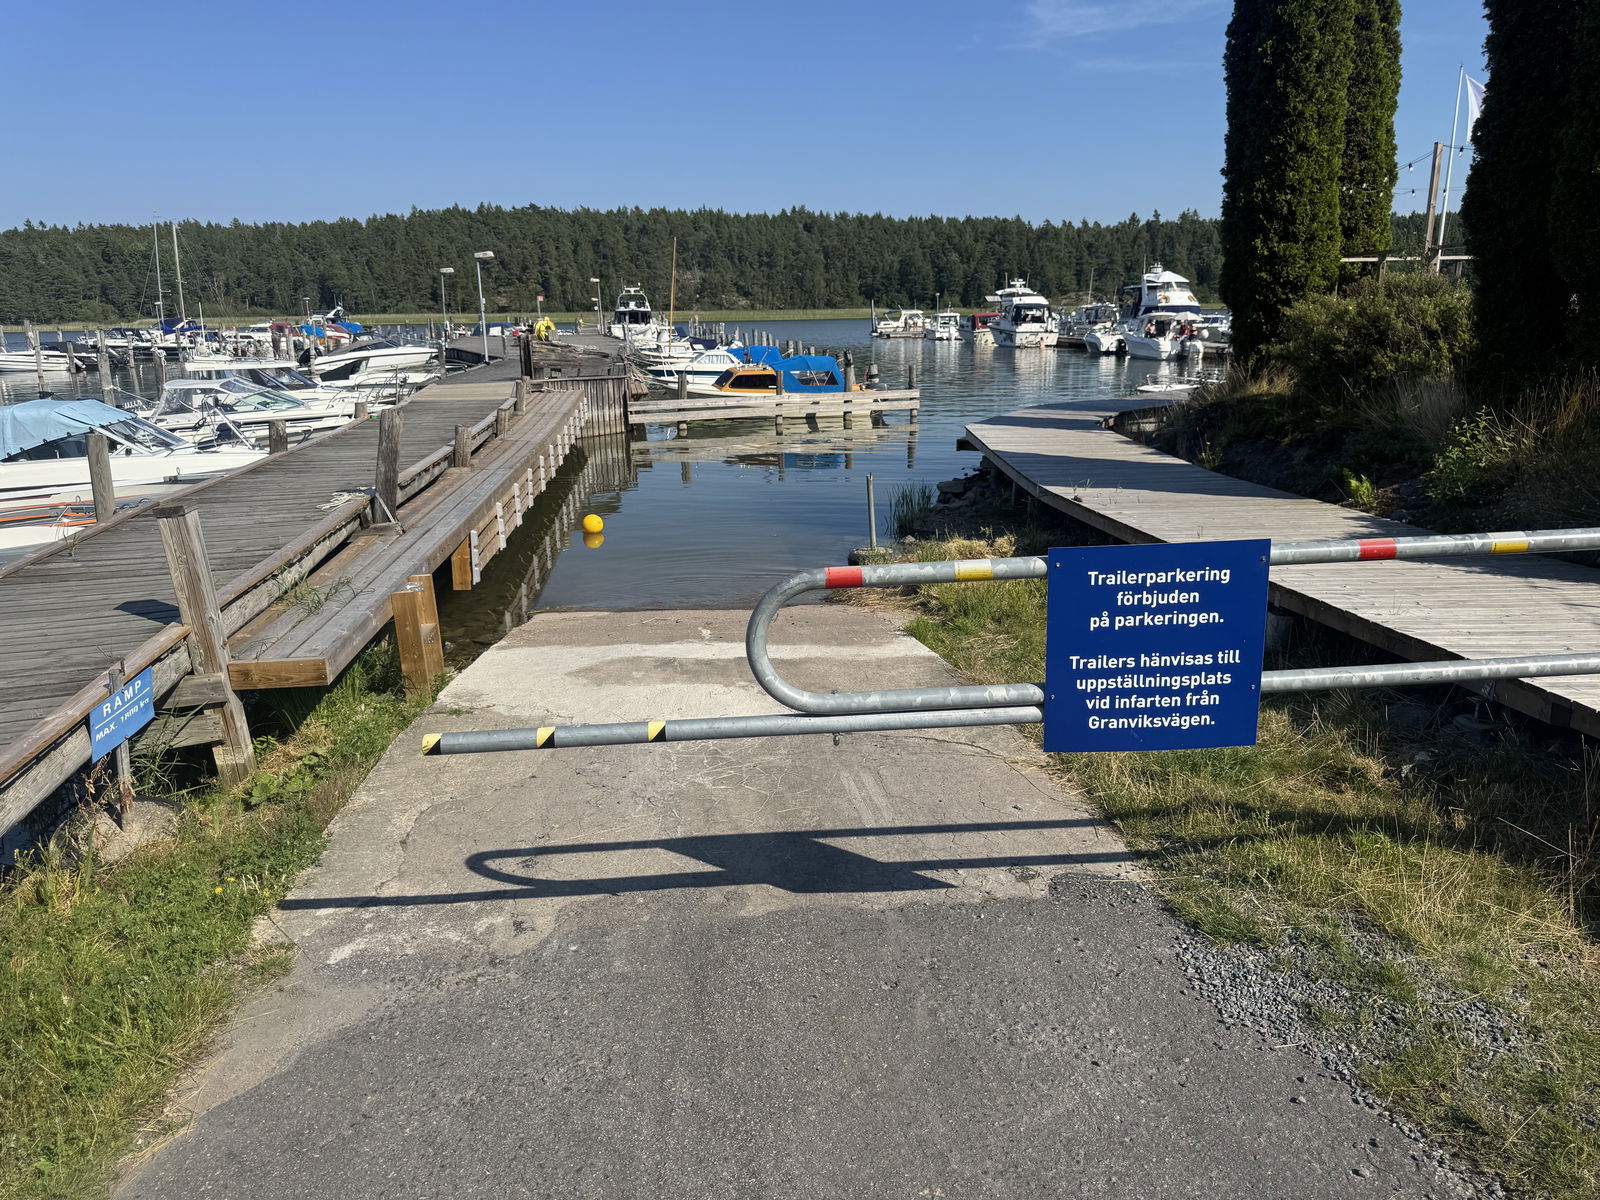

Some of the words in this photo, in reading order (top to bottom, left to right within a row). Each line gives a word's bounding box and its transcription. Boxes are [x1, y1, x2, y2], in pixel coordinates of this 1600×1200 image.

[1087, 567, 1231, 587] Trailerparkering
[1116, 590, 1200, 608] förbjuden
[1089, 611, 1110, 631] på
[1114, 610, 1224, 630] parkeringen.
[1069, 654, 1136, 670] Trailers
[1140, 651, 1214, 668] hänvisas
[1217, 649, 1241, 664] till
[1076, 671, 1232, 693] uppställningsplats
[103, 680, 142, 718] RAMP
[1085, 695, 1110, 710] vid
[1115, 694, 1181, 709] infarten
[1185, 690, 1220, 706] från
[1088, 712, 1215, 730] Granviksvägen.
[95, 722, 118, 742] MAX.
